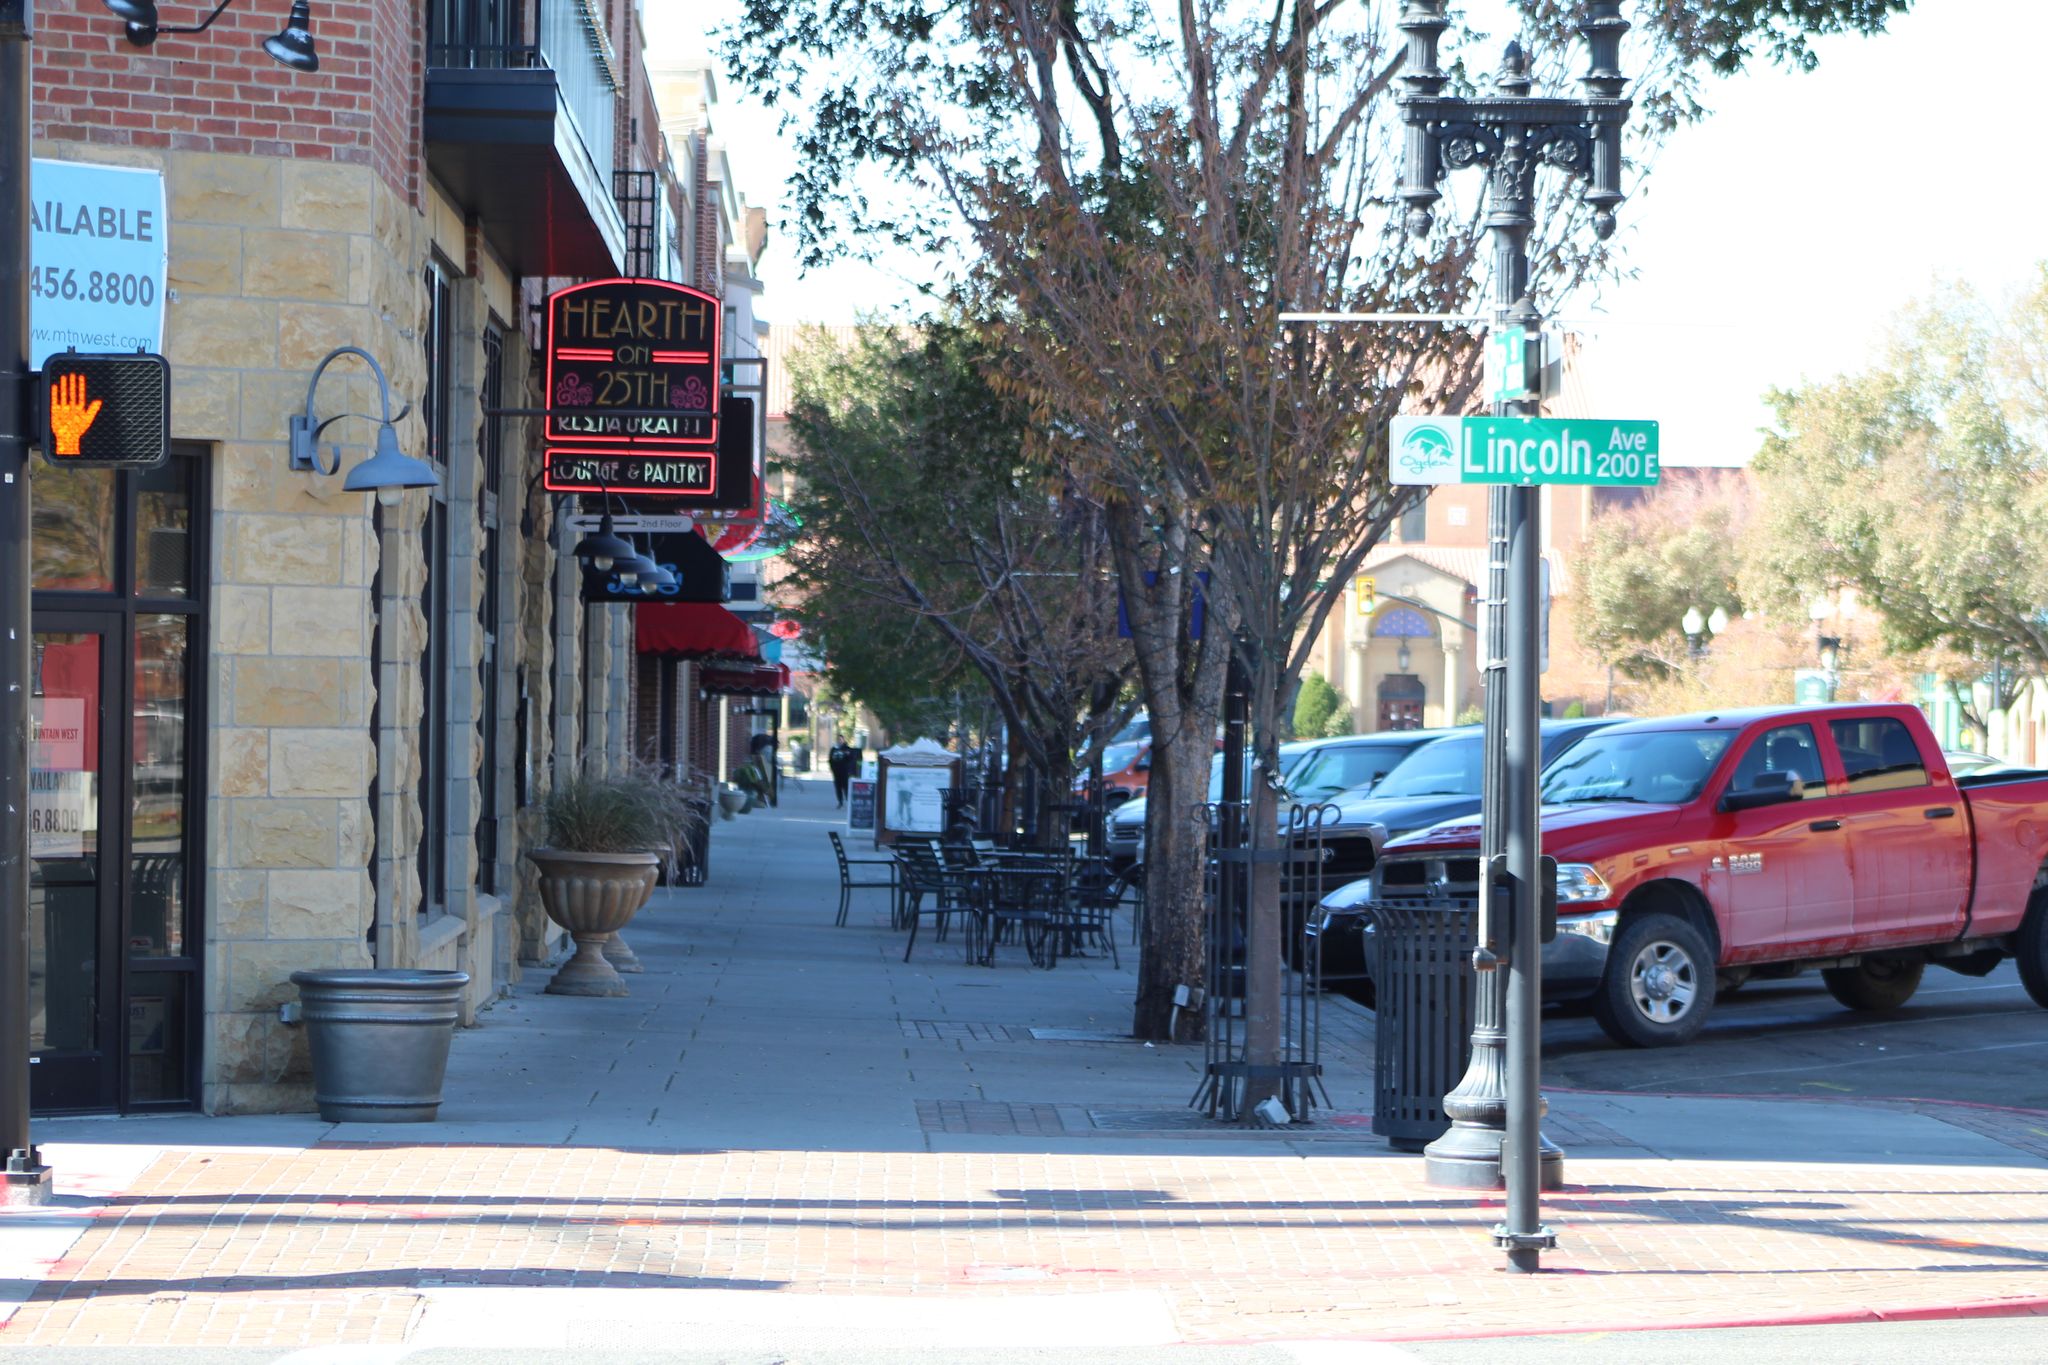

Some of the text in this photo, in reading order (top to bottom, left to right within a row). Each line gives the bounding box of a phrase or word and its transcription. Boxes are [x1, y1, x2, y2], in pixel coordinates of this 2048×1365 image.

[563, 299, 706, 340] HEARTH
[32, 327, 152, 349] w.mtnwest.com
[617, 345, 649, 365] ON
[596, 370, 669, 407] 25TH
[1608, 427, 1647, 450] Ave
[1464, 427, 1592, 475] Lincoln
[627, 463, 640, 480] &
[644, 461, 706, 483] PANTRY
[1399, 455, 1456, 475] Ogden
[1596, 453, 1658, 478] 200 E
[641, 520, 682, 528] 2nd Floor
[61, 728, 79, 740] WEST
